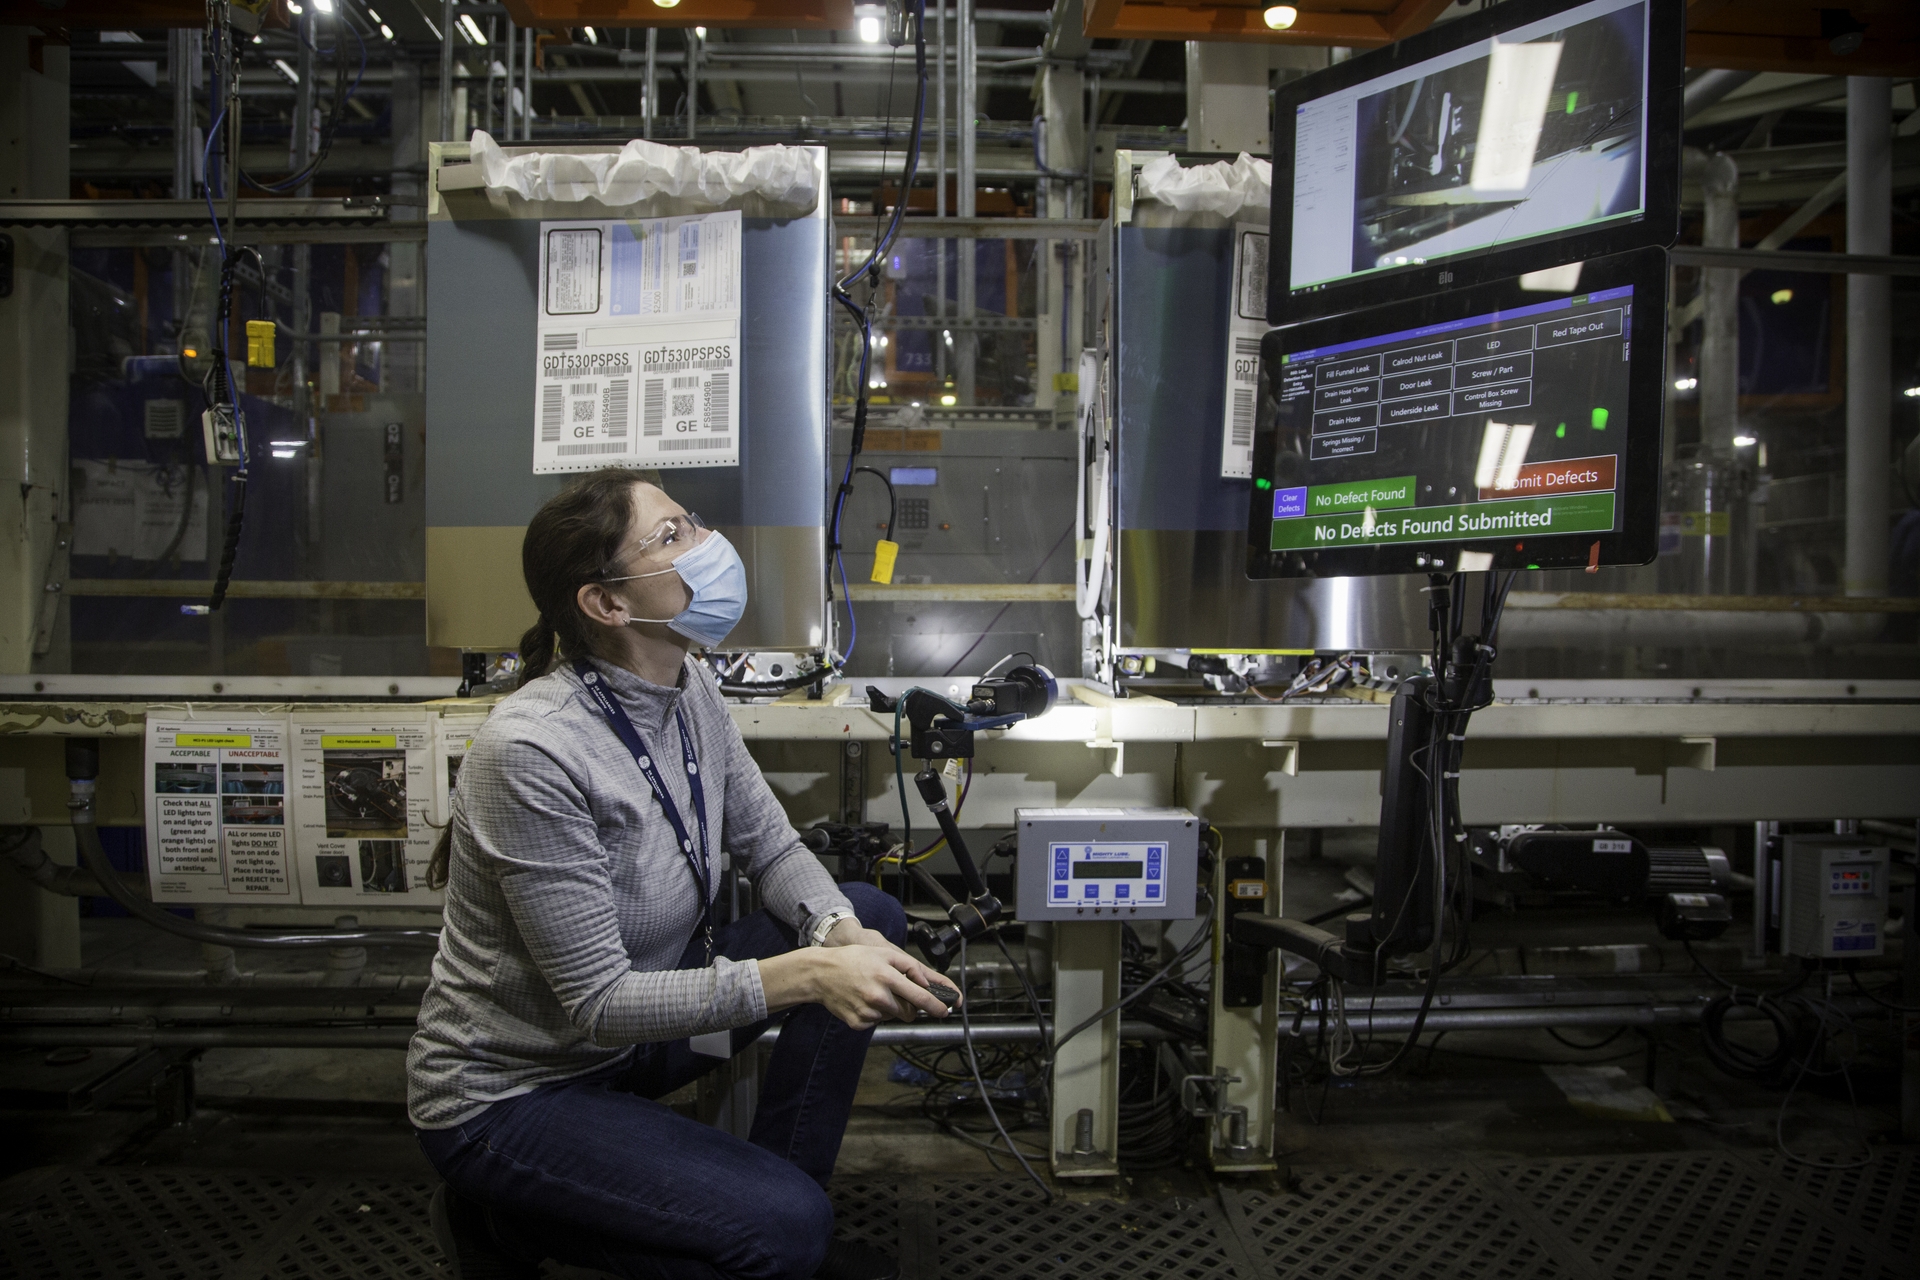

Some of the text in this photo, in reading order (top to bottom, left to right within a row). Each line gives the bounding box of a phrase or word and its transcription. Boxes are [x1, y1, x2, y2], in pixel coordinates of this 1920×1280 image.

[642, 291, 653, 314] WIN
[1552, 322, 1604, 338] Red Tape Out
[1486, 341, 1500, 350] LED
[644, 345, 730, 364] GDT530PSPSS
[906, 353, 932, 365] 733
[1392, 351, 1443, 366] Calrod Nut Leak
[544, 352, 629, 370] GDT530PSPSS
[1326, 364, 1370, 378] Fill Funnel Leak
[1472, 366, 1513, 378] Screw / Part
[1400, 379, 1432, 390] Door Leak
[1464, 392, 1486, 401] Control
[704, 381, 712, 428] FS855490B
[1390, 403, 1439, 416] Underside Leak
[1479, 400, 1502, 408] Missing
[602, 388, 610, 434] FS855490B
[676, 420, 698, 432] GE
[1328, 418, 1344, 426] Drain
[574, 426, 594, 438] GE
[1322, 439, 1341, 448] Springs
[1332, 446, 1354, 454] Incorrect
[1546, 470, 1598, 486] Defects
[1282, 494, 1298, 502] Clear
[1316, 487, 1406, 506] No Defect Found
[1278, 504, 1300, 513] Defects
[1314, 507, 1552, 541] No Defects Found Submitted
[170, 828, 192, 836] (green
